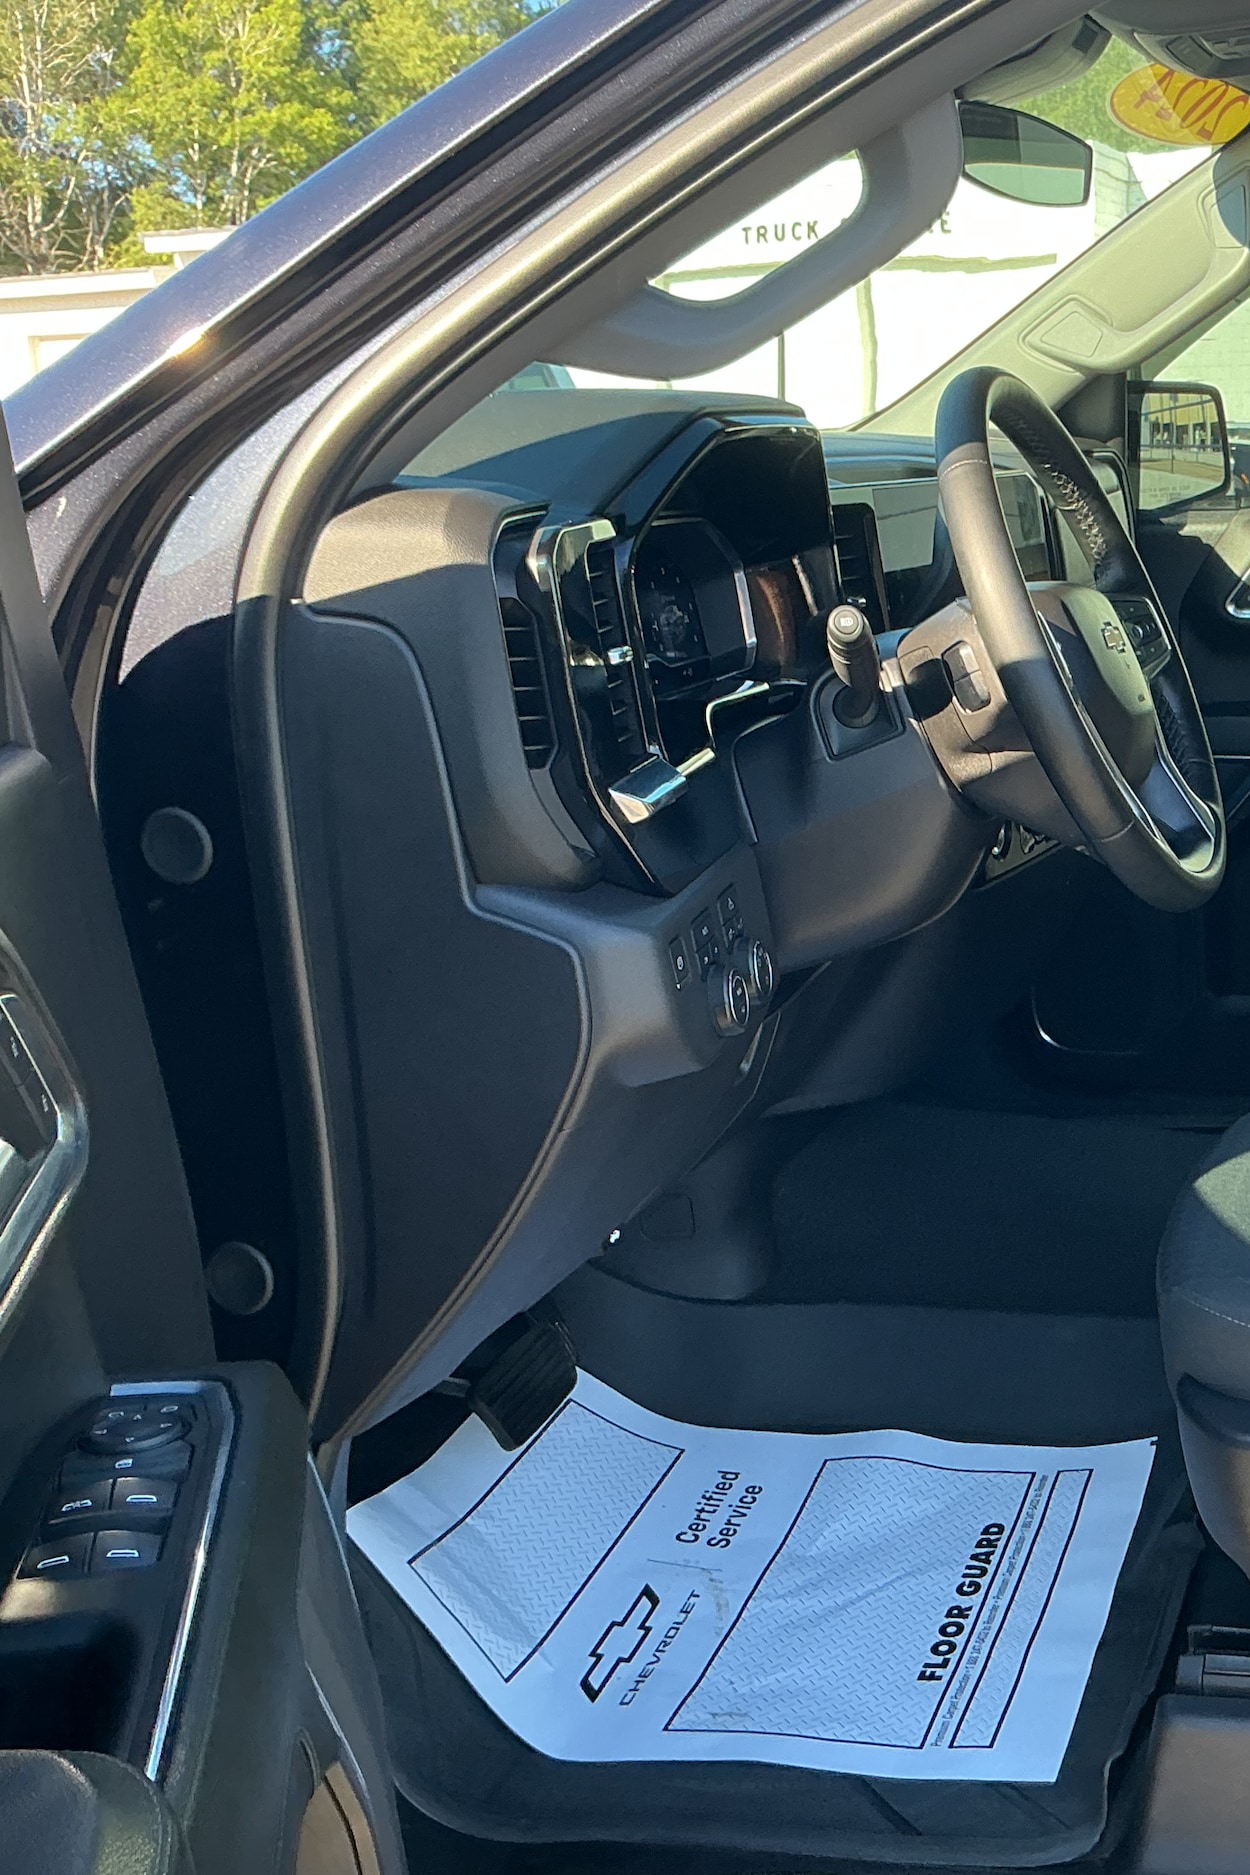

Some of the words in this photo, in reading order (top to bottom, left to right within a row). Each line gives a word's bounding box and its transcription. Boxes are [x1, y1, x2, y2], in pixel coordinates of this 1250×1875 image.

[742, 220, 819, 245] TRUCK
[675, 1470, 741, 1544] Certified
[706, 1484, 763, 1549] Service
[916, 1604, 974, 1682] FLOOR
[956, 1522, 1006, 1597] GUARD
[618, 1589, 701, 1707] CHEVROLET
